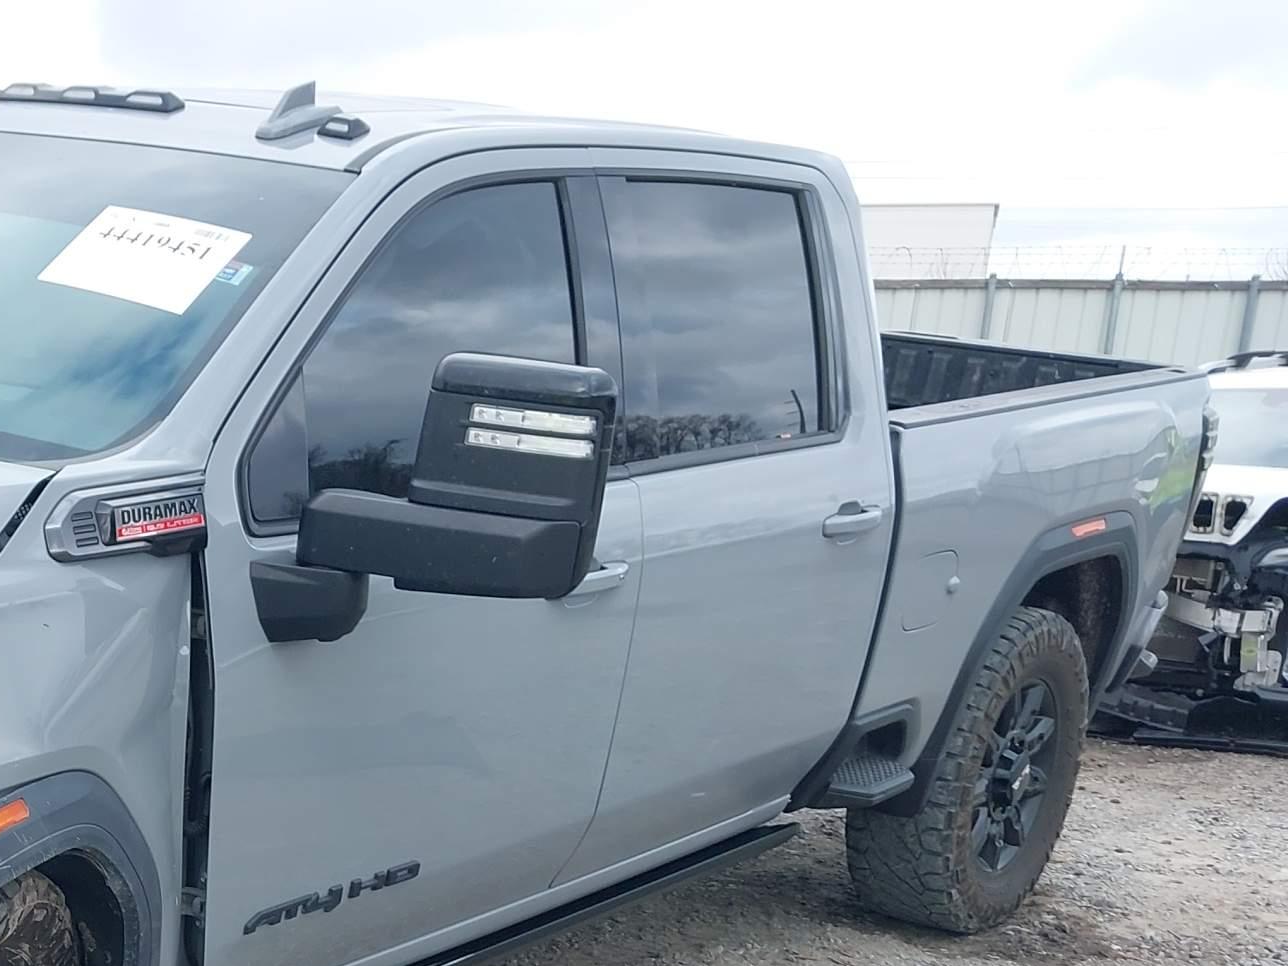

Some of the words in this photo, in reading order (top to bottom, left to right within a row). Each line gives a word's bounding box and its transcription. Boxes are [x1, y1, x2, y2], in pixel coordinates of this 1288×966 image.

[120, 498, 198, 525] DURAMAX
[243, 883, 344, 936] AT4
[346, 859, 421, 899] HD
